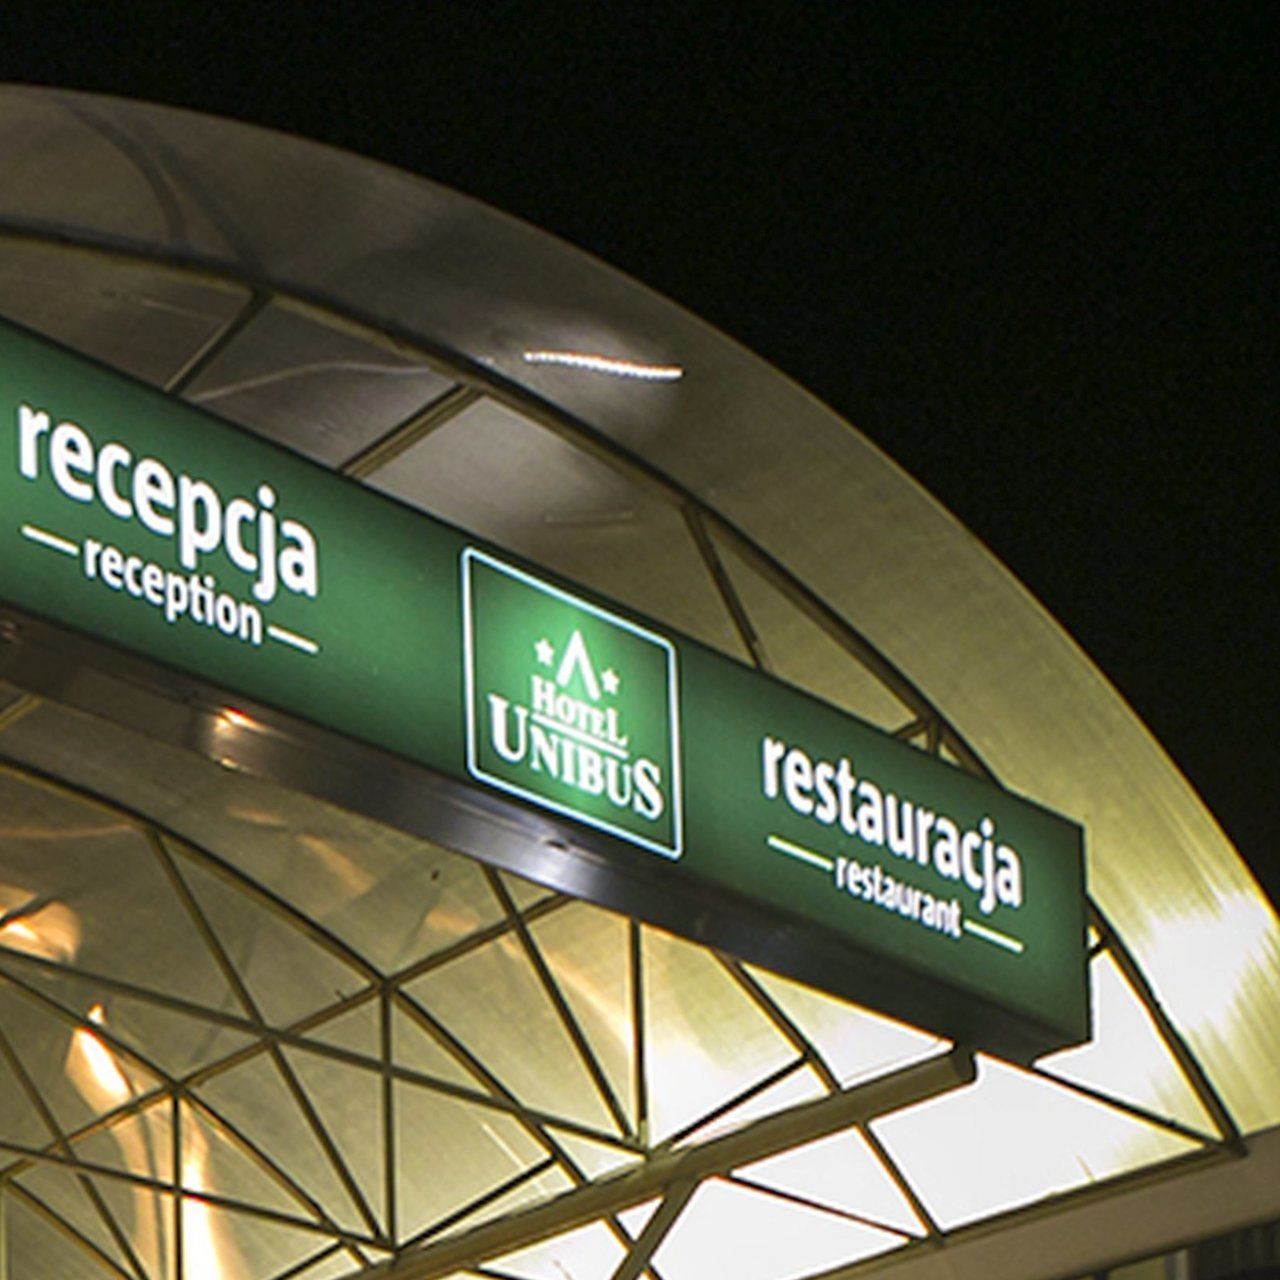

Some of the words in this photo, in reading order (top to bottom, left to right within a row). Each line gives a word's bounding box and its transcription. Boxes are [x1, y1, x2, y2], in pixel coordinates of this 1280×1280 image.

[19, 404, 317, 602] recepcja
[83, 538, 263, 646] reception
[488, 693, 664, 820] UNIBUS
[531, 674, 627, 746] HOTEL
[763, 736, 1023, 914] restauracja
[835, 857, 962, 938] restaurant
